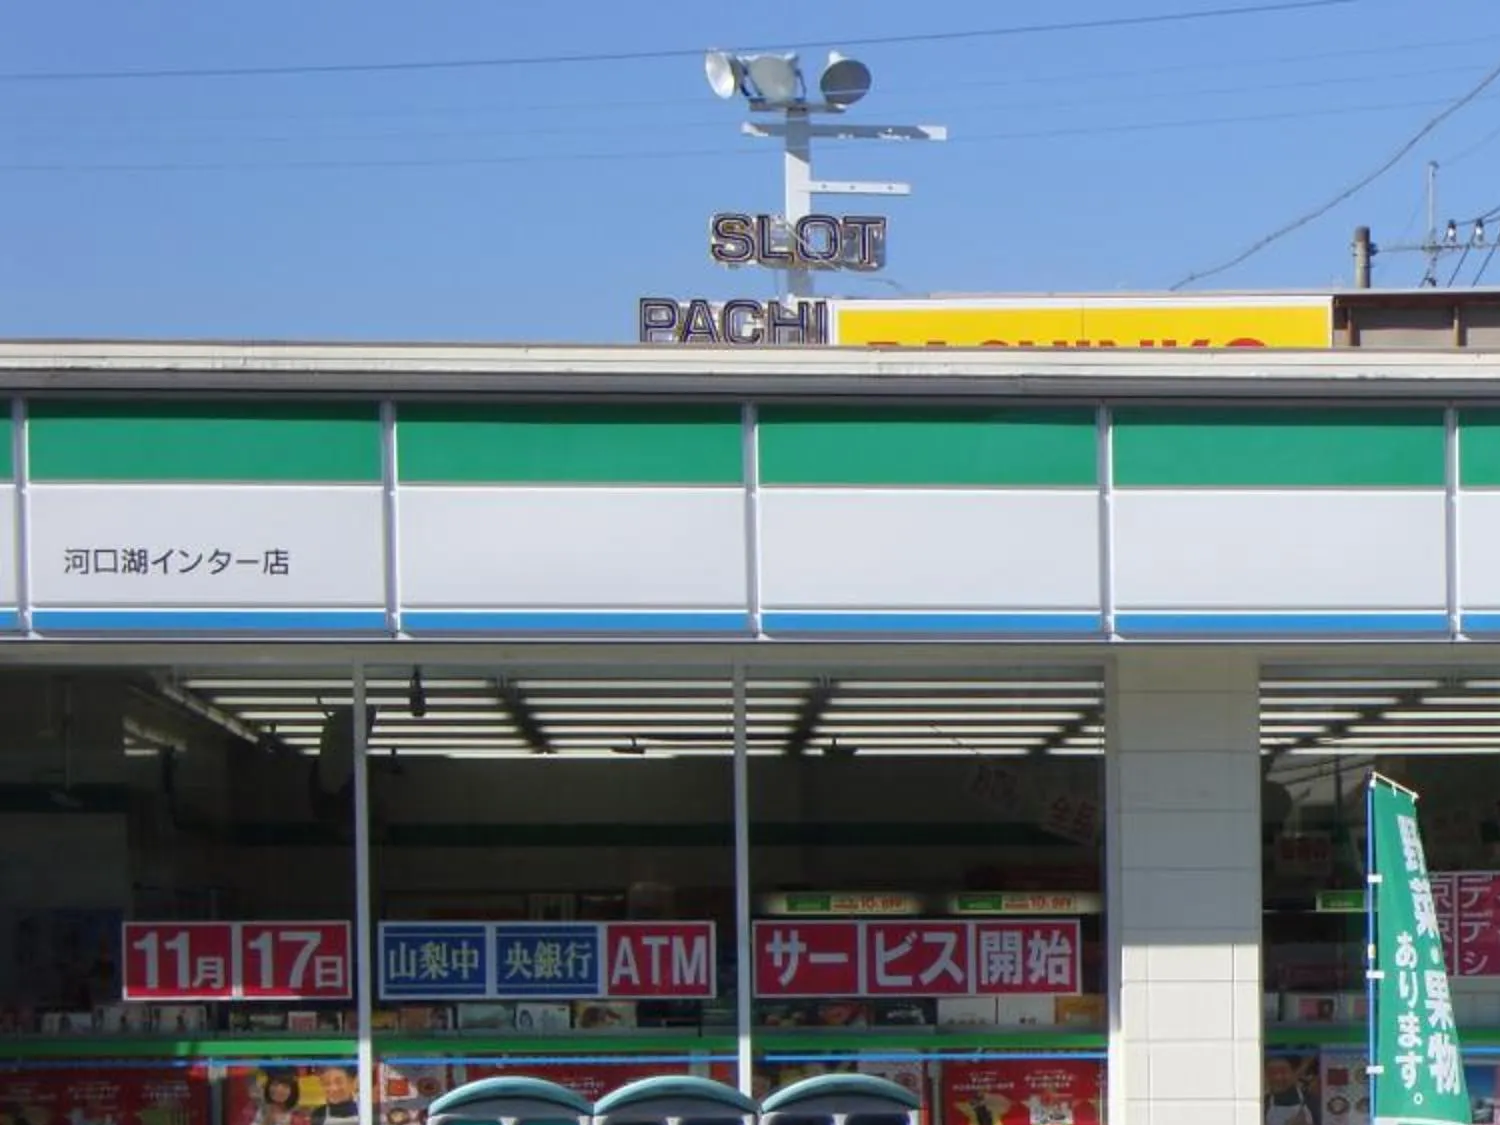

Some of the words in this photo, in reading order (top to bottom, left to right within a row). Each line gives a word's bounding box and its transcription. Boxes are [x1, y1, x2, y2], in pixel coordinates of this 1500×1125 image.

[711, 213, 886, 270] SLOT
[640, 298, 830, 345] PACHI
[64, 548, 289, 575] 河口湖インター店
[133, 931, 343, 989] 11月17日
[388, 942, 593, 980] 山梨中央銀行
[611, 936, 707, 986] ATM
[766, 928, 1072, 987] サービス開始
[1395, 931, 1425, 1105] あります。
